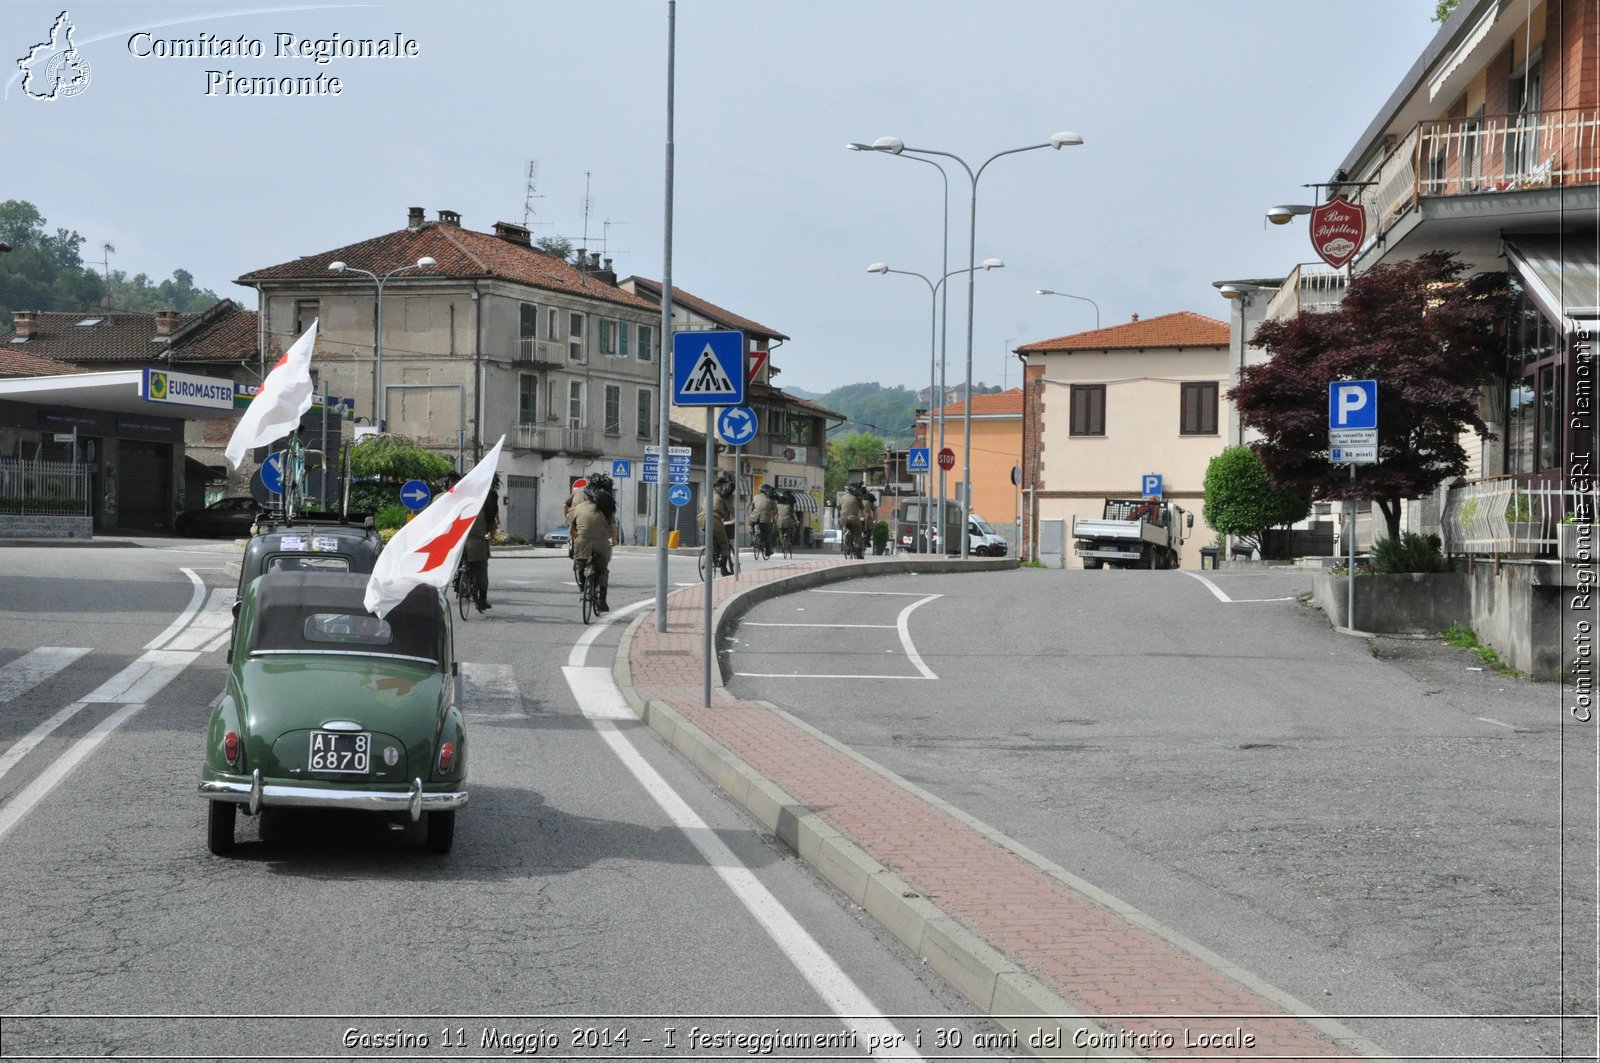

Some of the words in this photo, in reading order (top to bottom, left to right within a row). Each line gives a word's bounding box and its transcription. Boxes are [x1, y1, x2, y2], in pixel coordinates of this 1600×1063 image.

[1323, 210, 1352, 222] Bar
[1325, 243, 1353, 253] Giuliano
[169, 380, 233, 402] EUROMASTER
[1339, 386, 1367, 424] P
[939, 454, 955, 464] STOP
[1146, 477, 1158, 493] P
[314, 734, 339, 751] AT
[355, 736, 366, 752] 8
[313, 752, 366, 769] 6870
